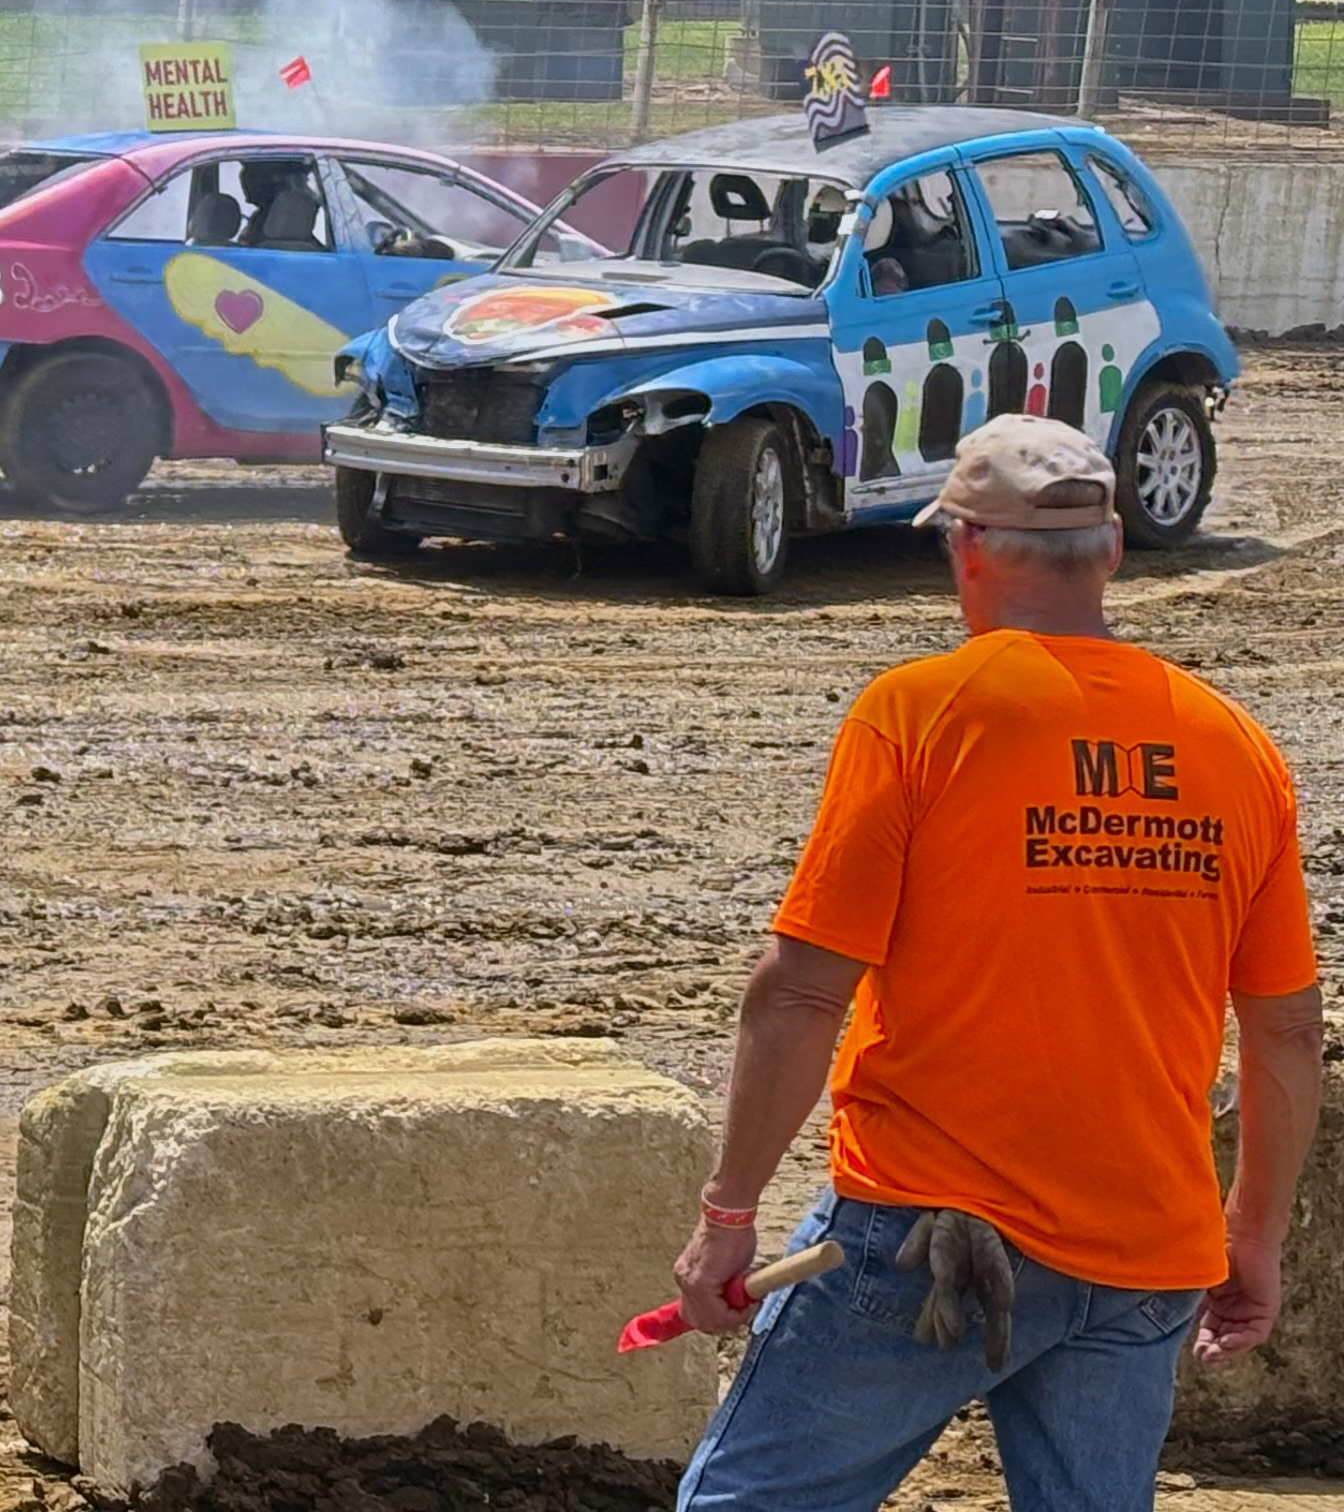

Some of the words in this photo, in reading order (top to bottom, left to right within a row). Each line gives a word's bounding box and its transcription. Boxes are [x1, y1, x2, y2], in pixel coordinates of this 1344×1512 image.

[144, 58, 228, 87] MENTAL
[148, 89, 228, 120] HEALTH
[1025, 805, 1223, 846] McDermott
[1025, 838, 1221, 883] Excavating
